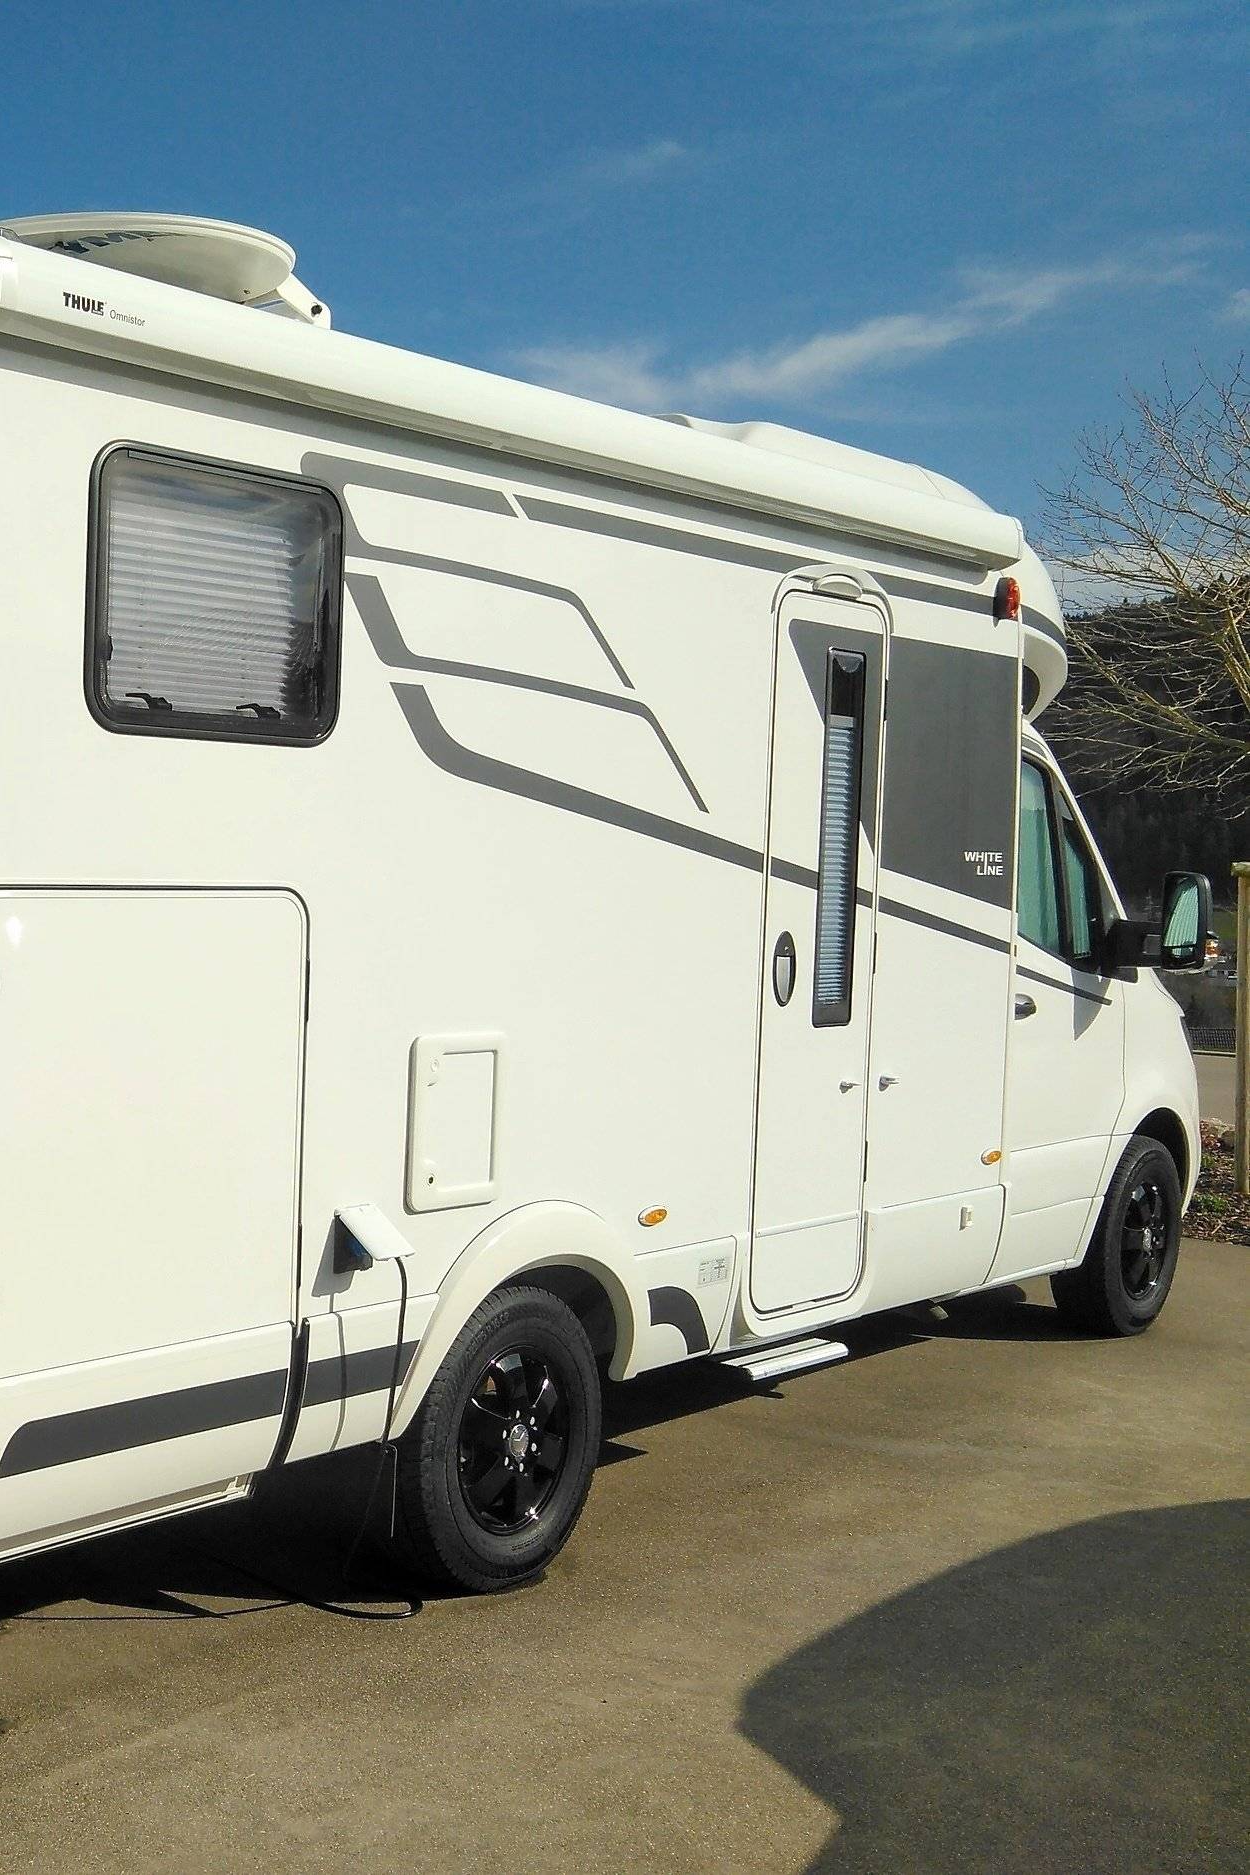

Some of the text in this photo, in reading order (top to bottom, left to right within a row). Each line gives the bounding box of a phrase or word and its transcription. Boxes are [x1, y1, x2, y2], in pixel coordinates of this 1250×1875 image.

[63, 292, 146, 326] THULE Omnistor
[964, 851, 1003, 862] WHITE
[976, 865, 1004, 876] LINE
